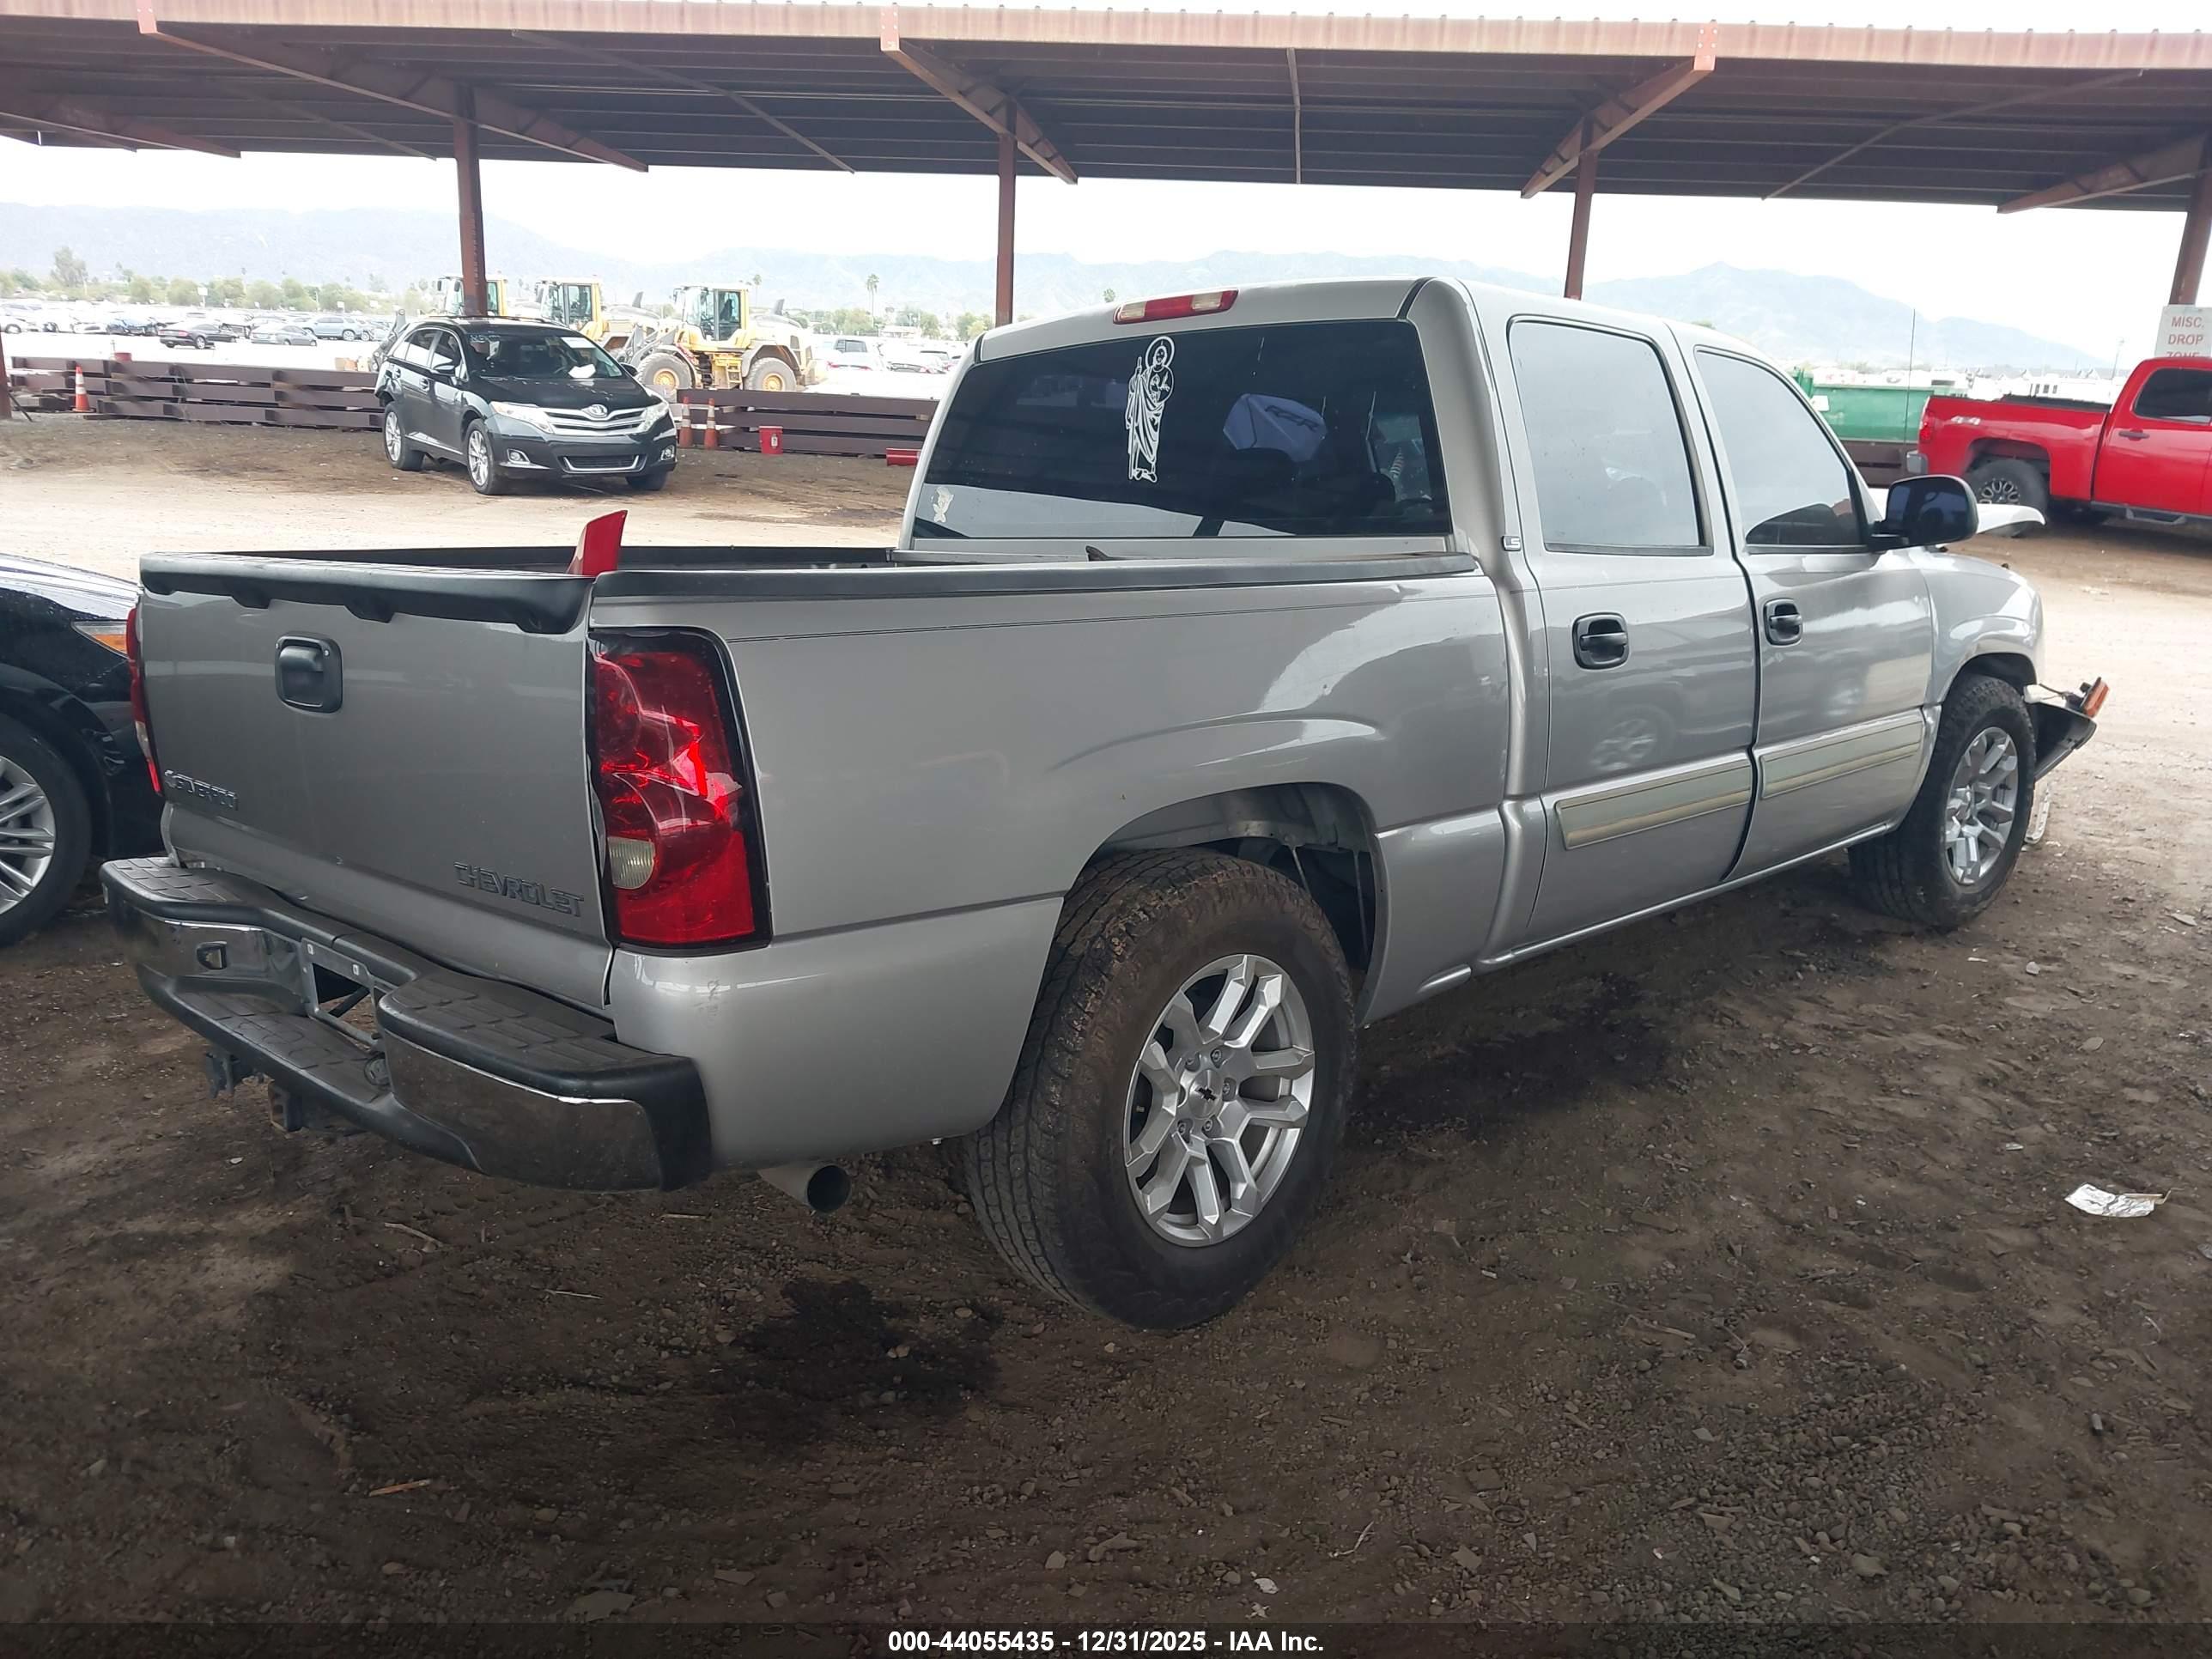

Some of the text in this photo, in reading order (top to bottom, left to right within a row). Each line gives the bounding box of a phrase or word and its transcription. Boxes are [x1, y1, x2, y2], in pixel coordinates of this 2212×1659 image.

[2171, 315, 2204, 329] MISC.
[2167, 333, 2204, 345] DROP
[453, 861, 585, 917] CHEVROLET
